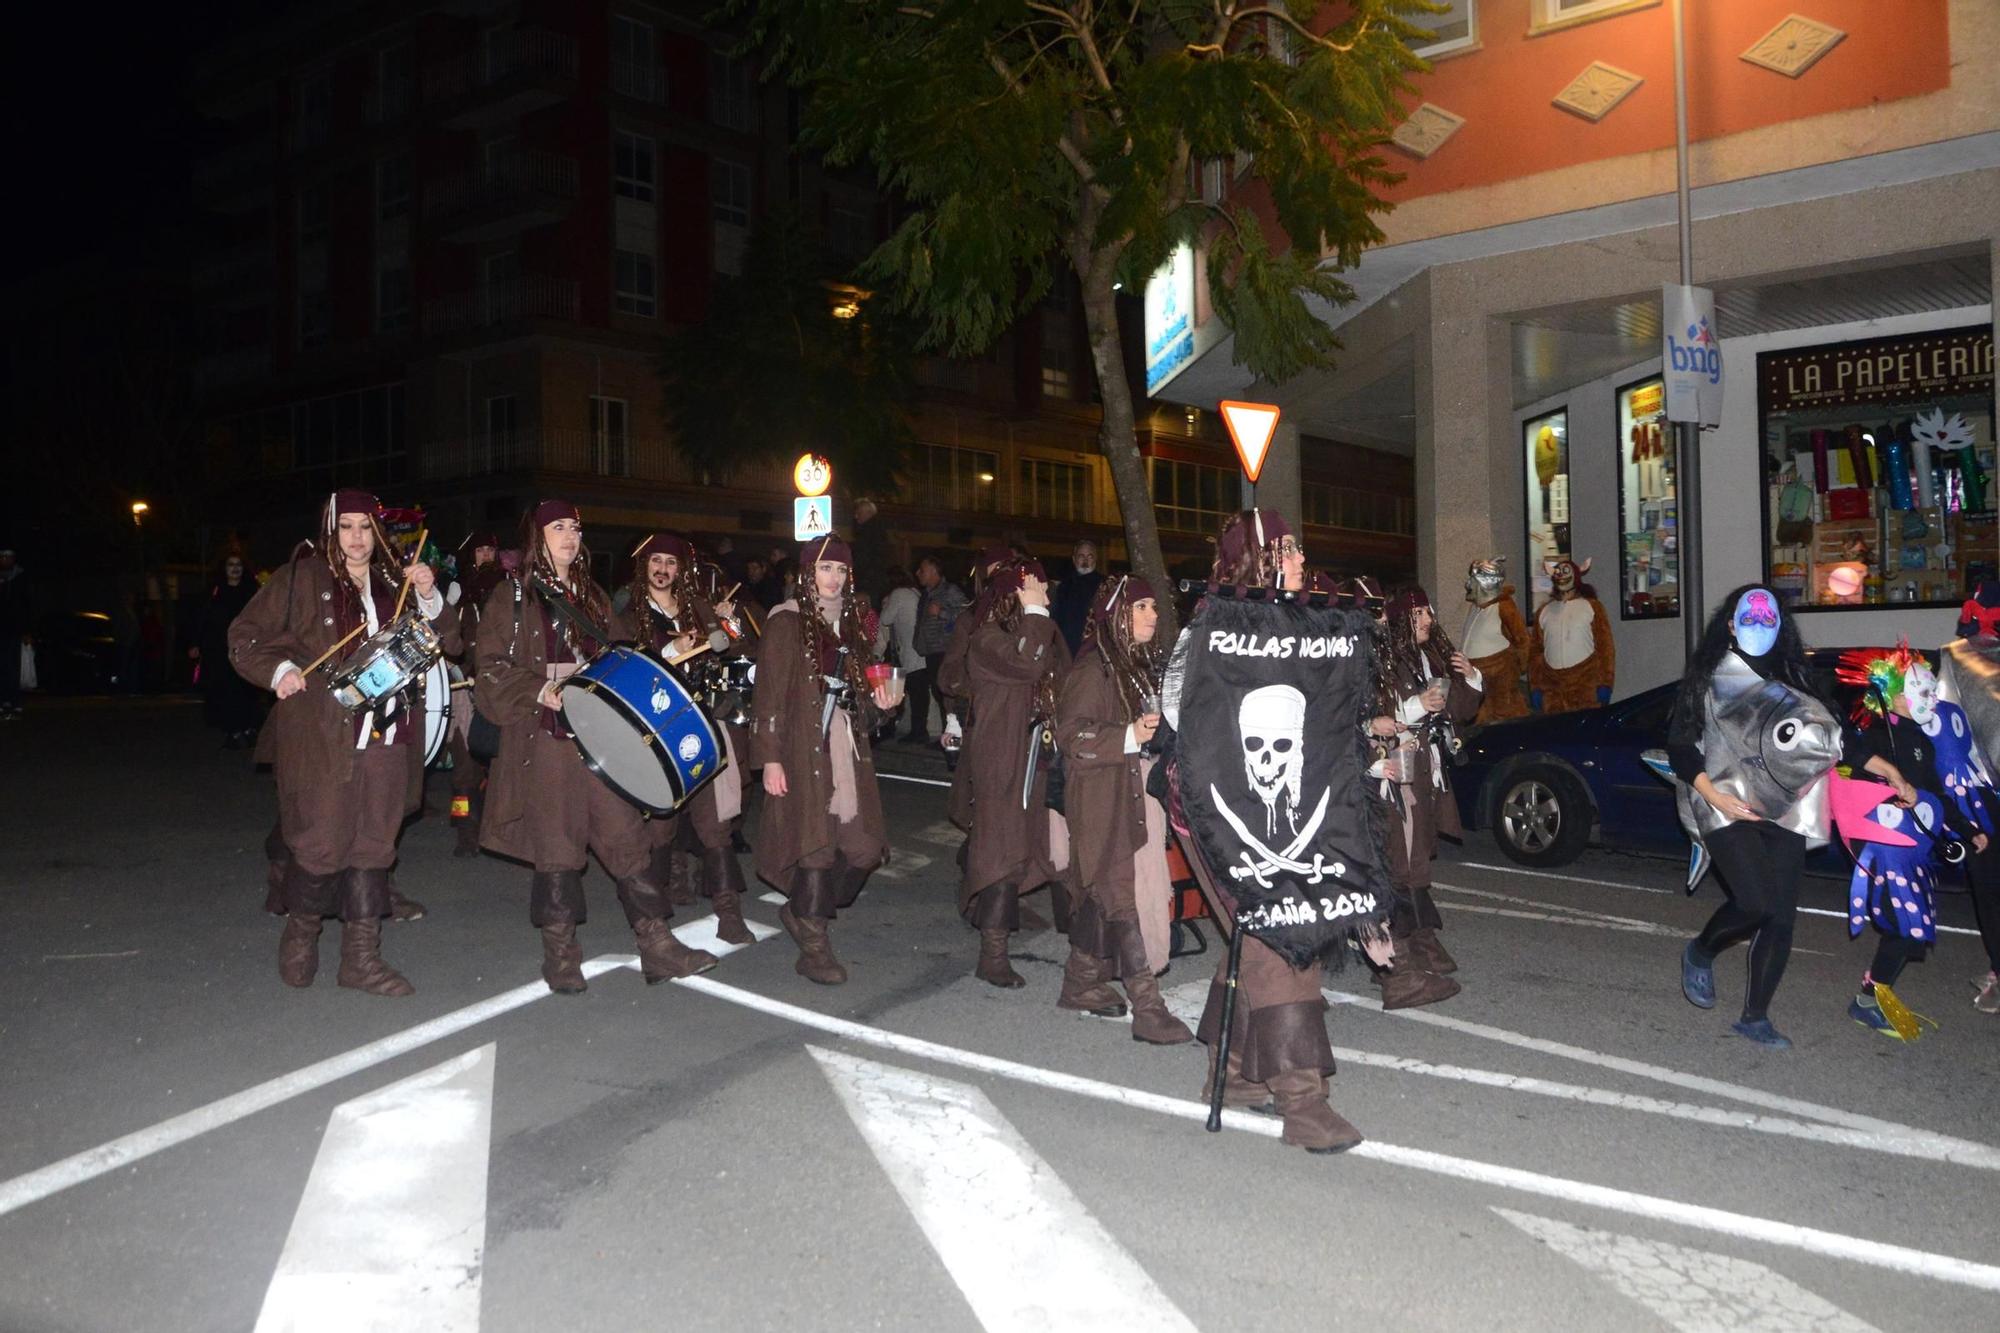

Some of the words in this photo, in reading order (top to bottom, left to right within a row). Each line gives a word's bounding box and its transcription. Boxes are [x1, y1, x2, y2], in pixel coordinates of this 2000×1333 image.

[1668, 335, 1720, 384] bng
[1788, 364, 1821, 395] LA
[1837, 339, 1994, 389] PAPELERÍA
[803, 467, 822, 482] 30
[1209, 631, 1296, 659] FOLLAS
[1299, 635, 1358, 659] NOVAS
[1320, 892, 1377, 920] 2024
